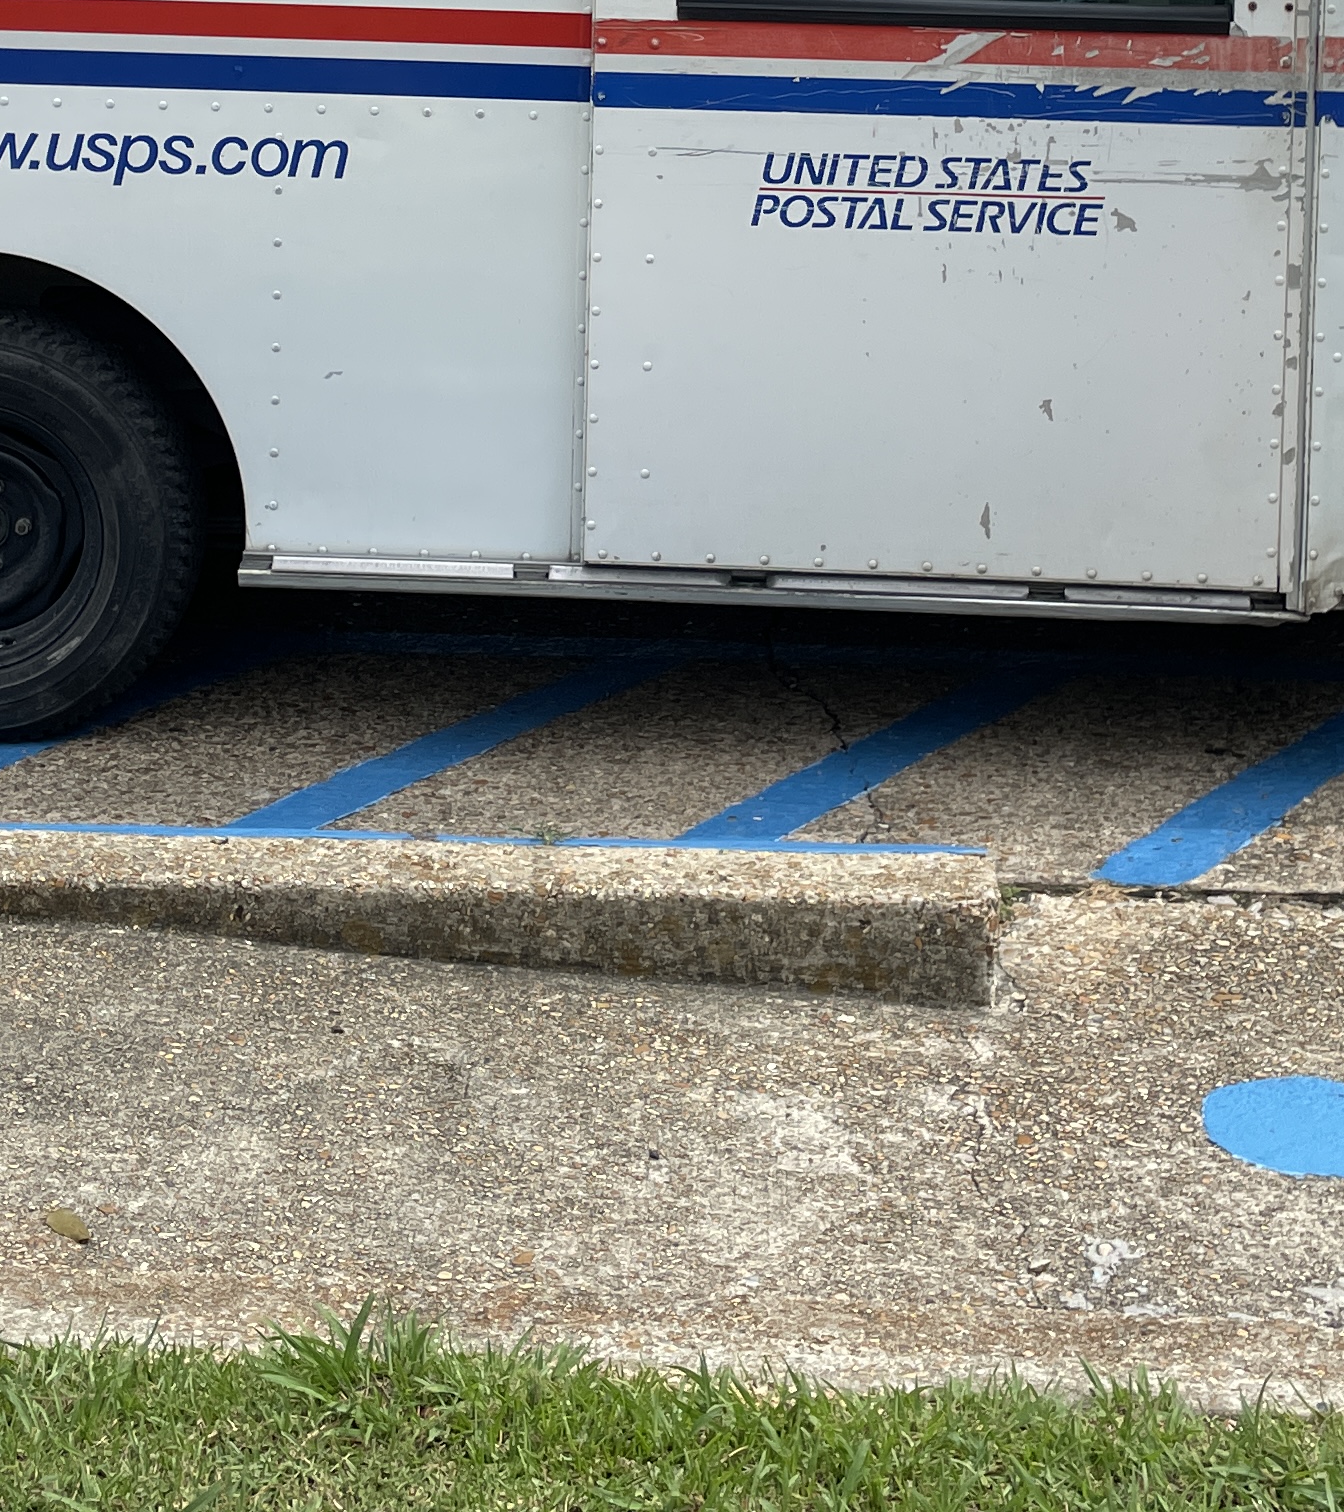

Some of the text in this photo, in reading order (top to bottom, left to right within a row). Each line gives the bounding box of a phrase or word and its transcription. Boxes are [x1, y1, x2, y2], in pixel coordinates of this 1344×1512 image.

[762, 152, 1092, 193] UNITED STATES
[751, 194, 1102, 236] POSTAL SERVICE
